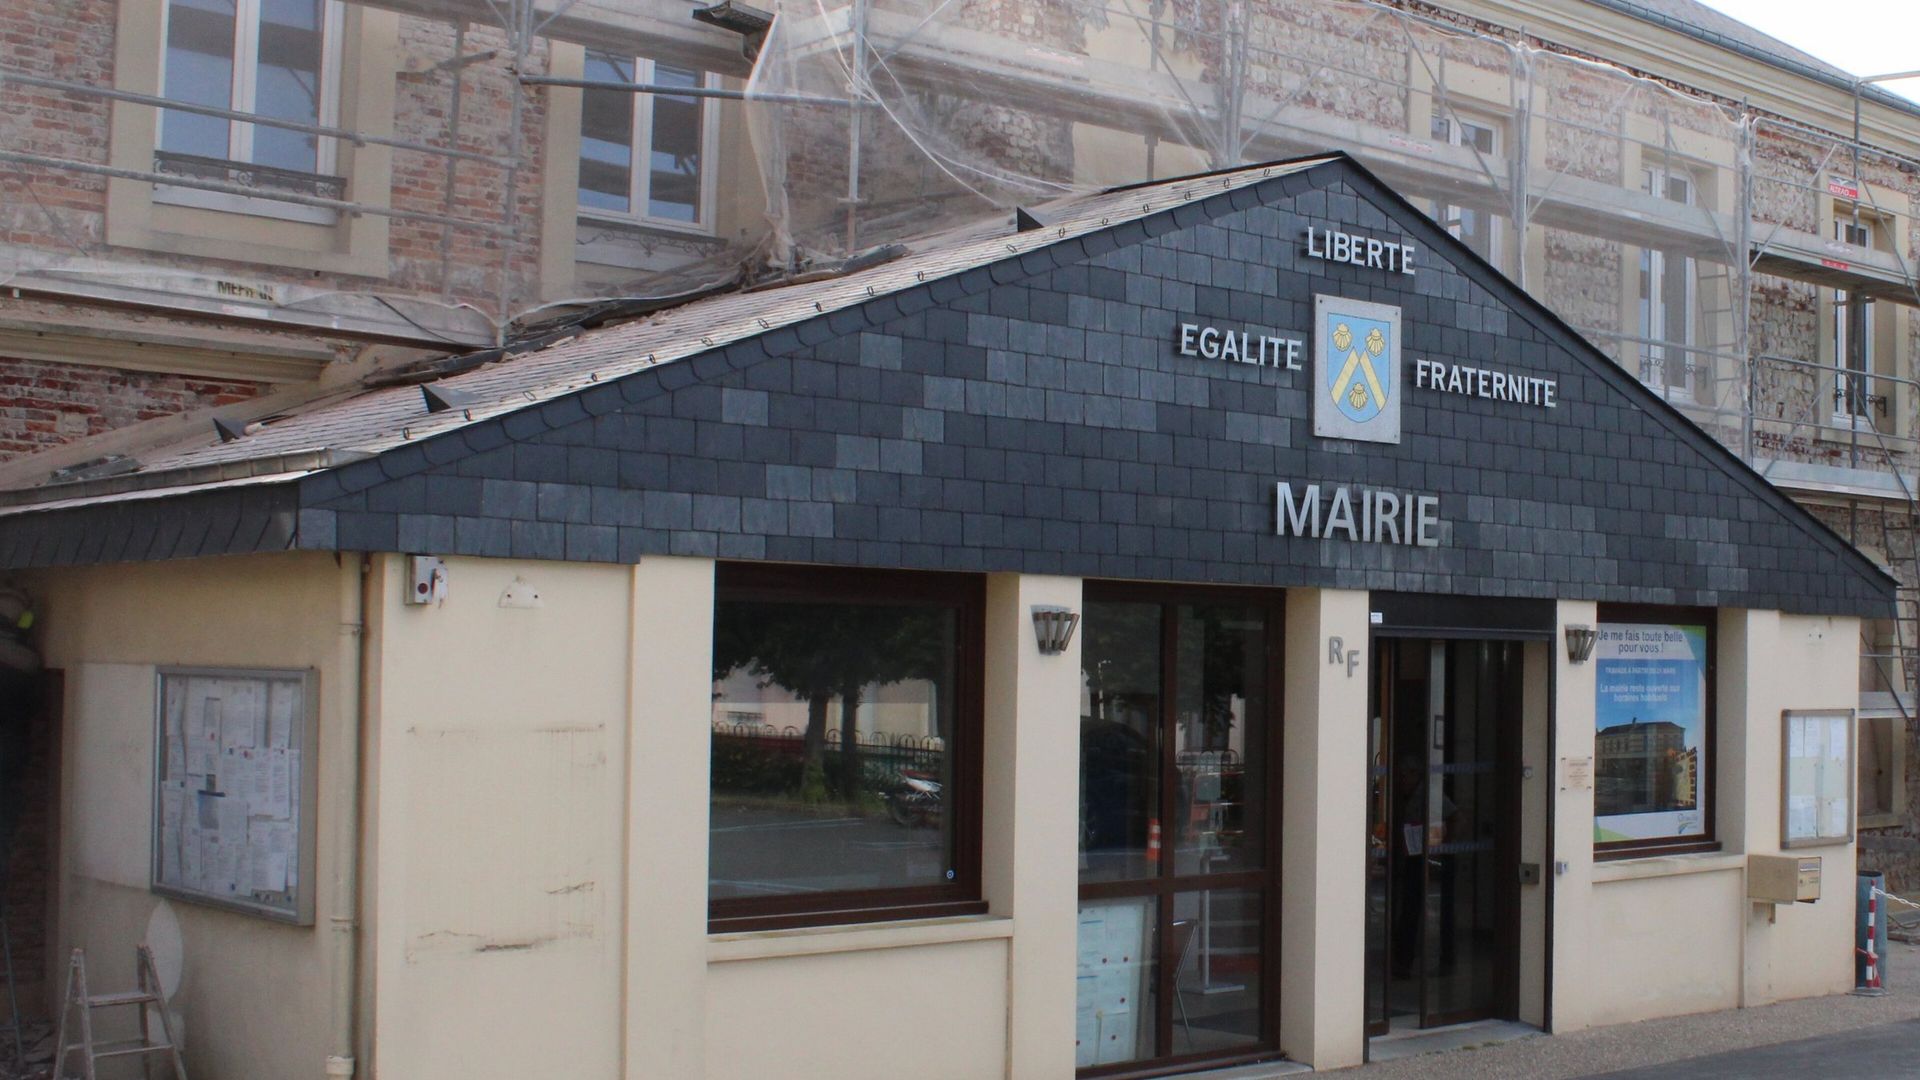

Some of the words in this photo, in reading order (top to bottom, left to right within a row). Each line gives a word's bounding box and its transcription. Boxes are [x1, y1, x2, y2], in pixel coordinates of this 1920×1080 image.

[1308, 226, 1416, 276] LIBERTE
[1180, 323, 1303, 371] EGALITE
[1416, 359, 1558, 408] FRATERNITE
[1276, 481, 1440, 548] MAIRIE
[1599, 629, 1609, 641] Je
[1610, 631, 1624, 641] me
[1625, 630, 1640, 641] fais
[1641, 631, 1662, 641] toute
[1664, 631, 1684, 642] belle
[1618, 643, 1638, 655] pour
[1640, 643, 1660, 653] vous
